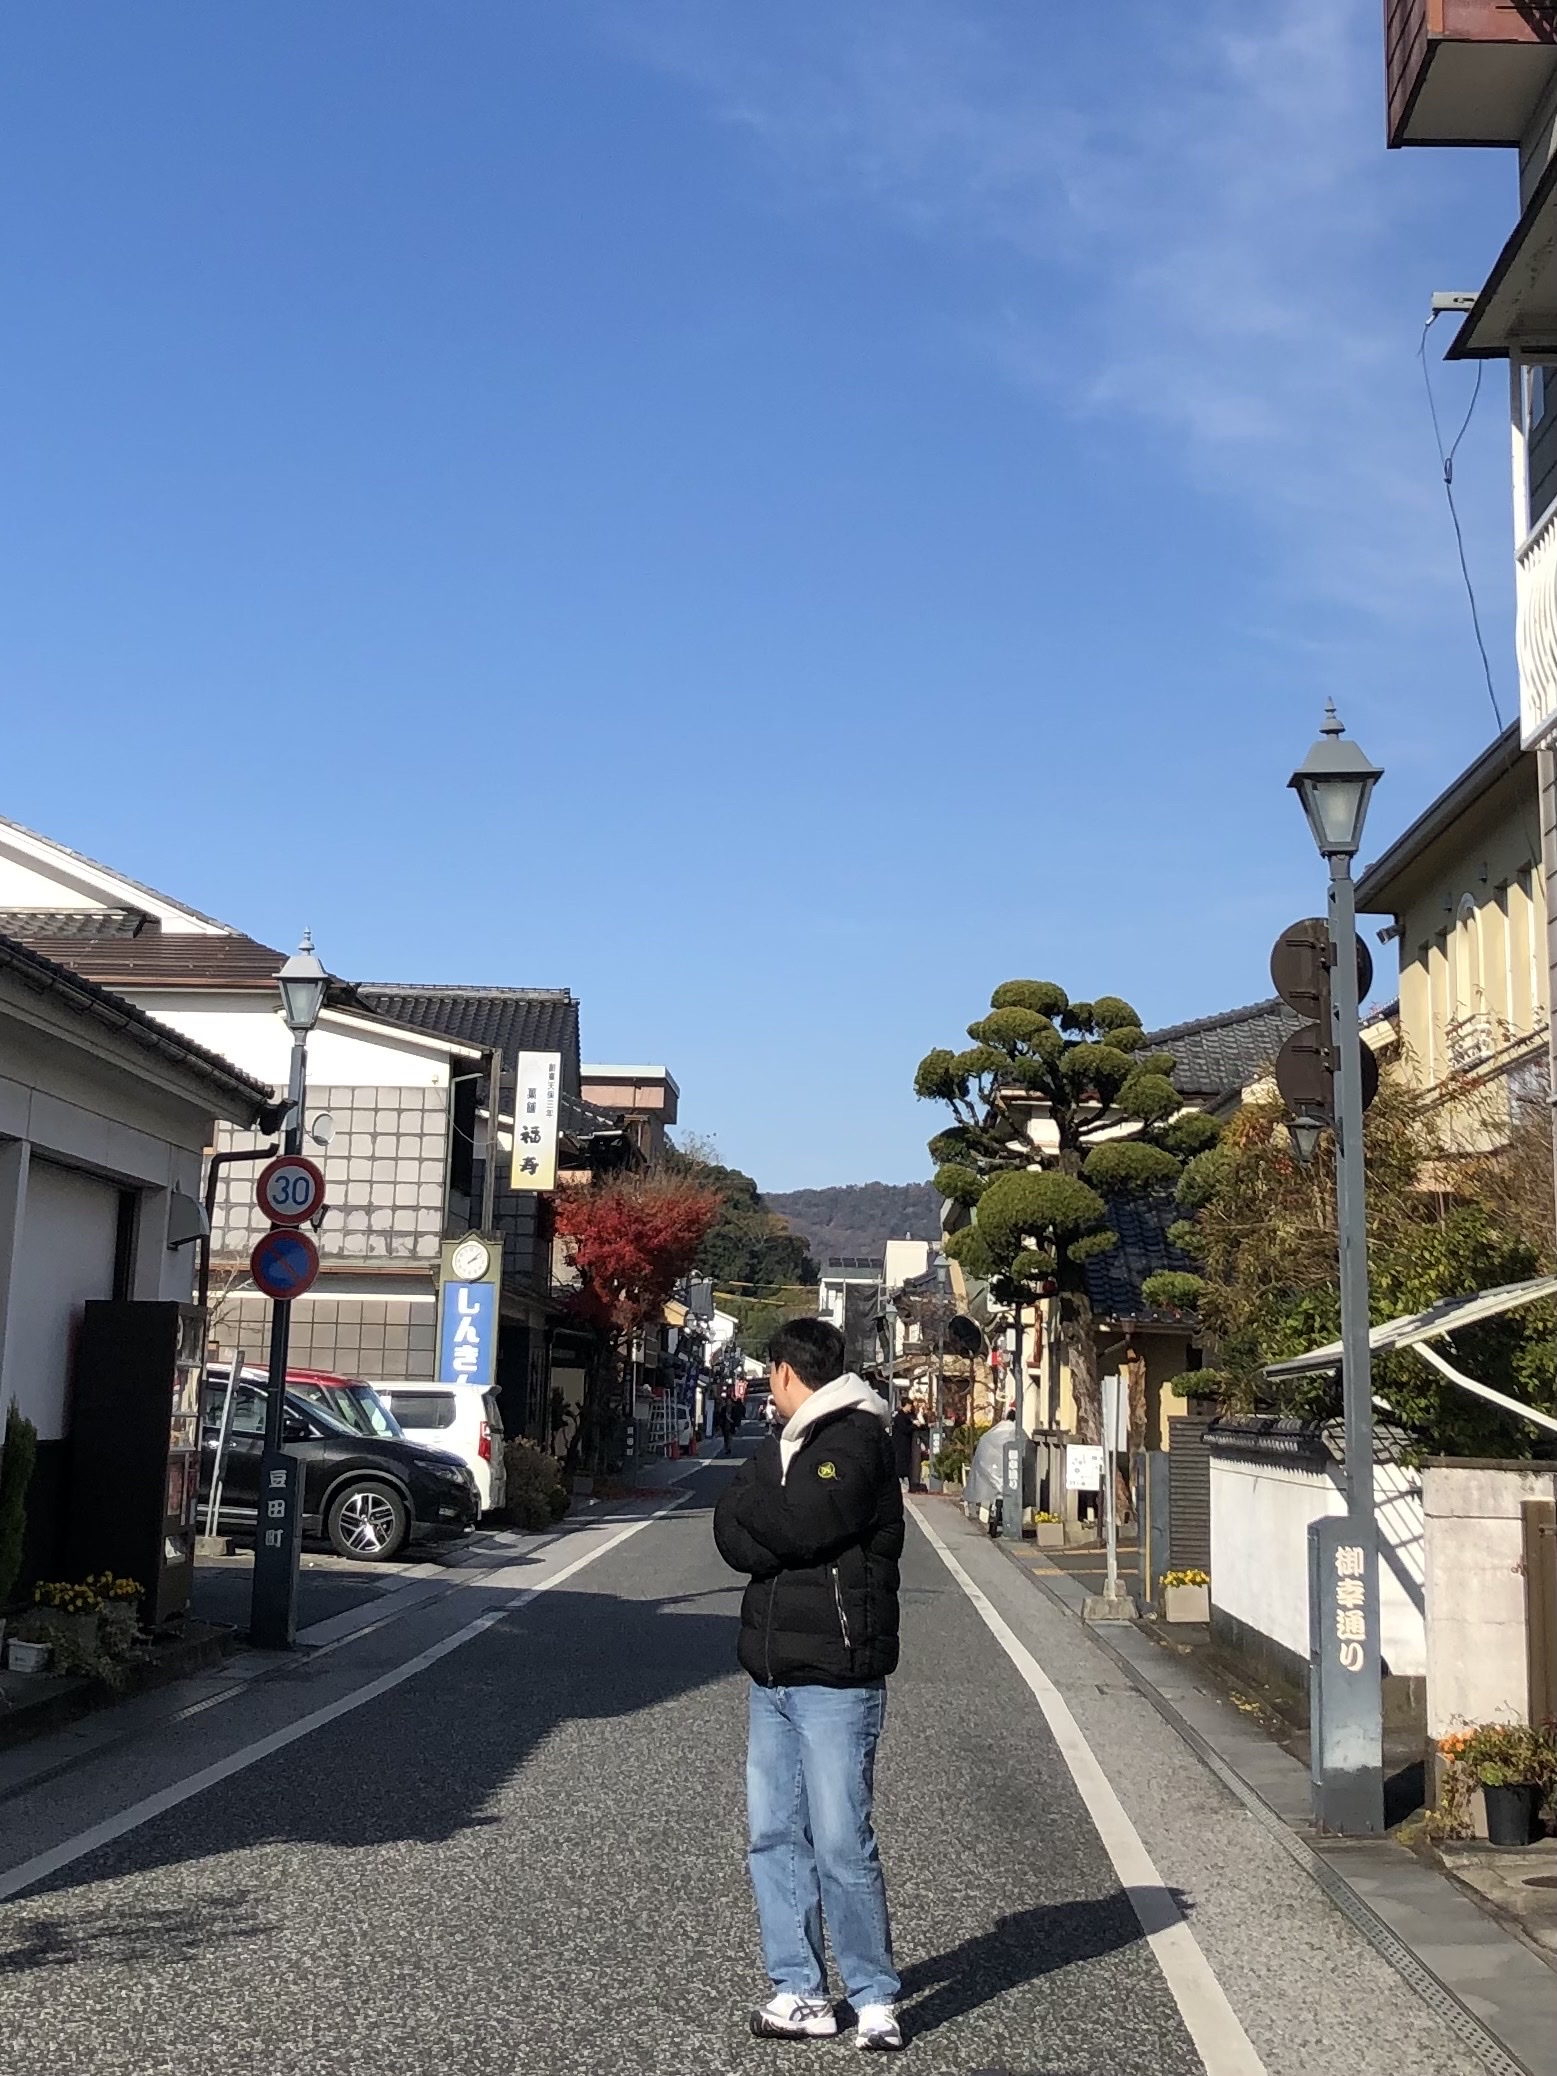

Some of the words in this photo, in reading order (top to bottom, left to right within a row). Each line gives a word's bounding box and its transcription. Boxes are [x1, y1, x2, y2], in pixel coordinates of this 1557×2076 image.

[272, 1175, 310, 1206] 30
[265, 1469, 288, 1548] 豆田町
[1335, 1545, 1367, 1672] 御幸通り
